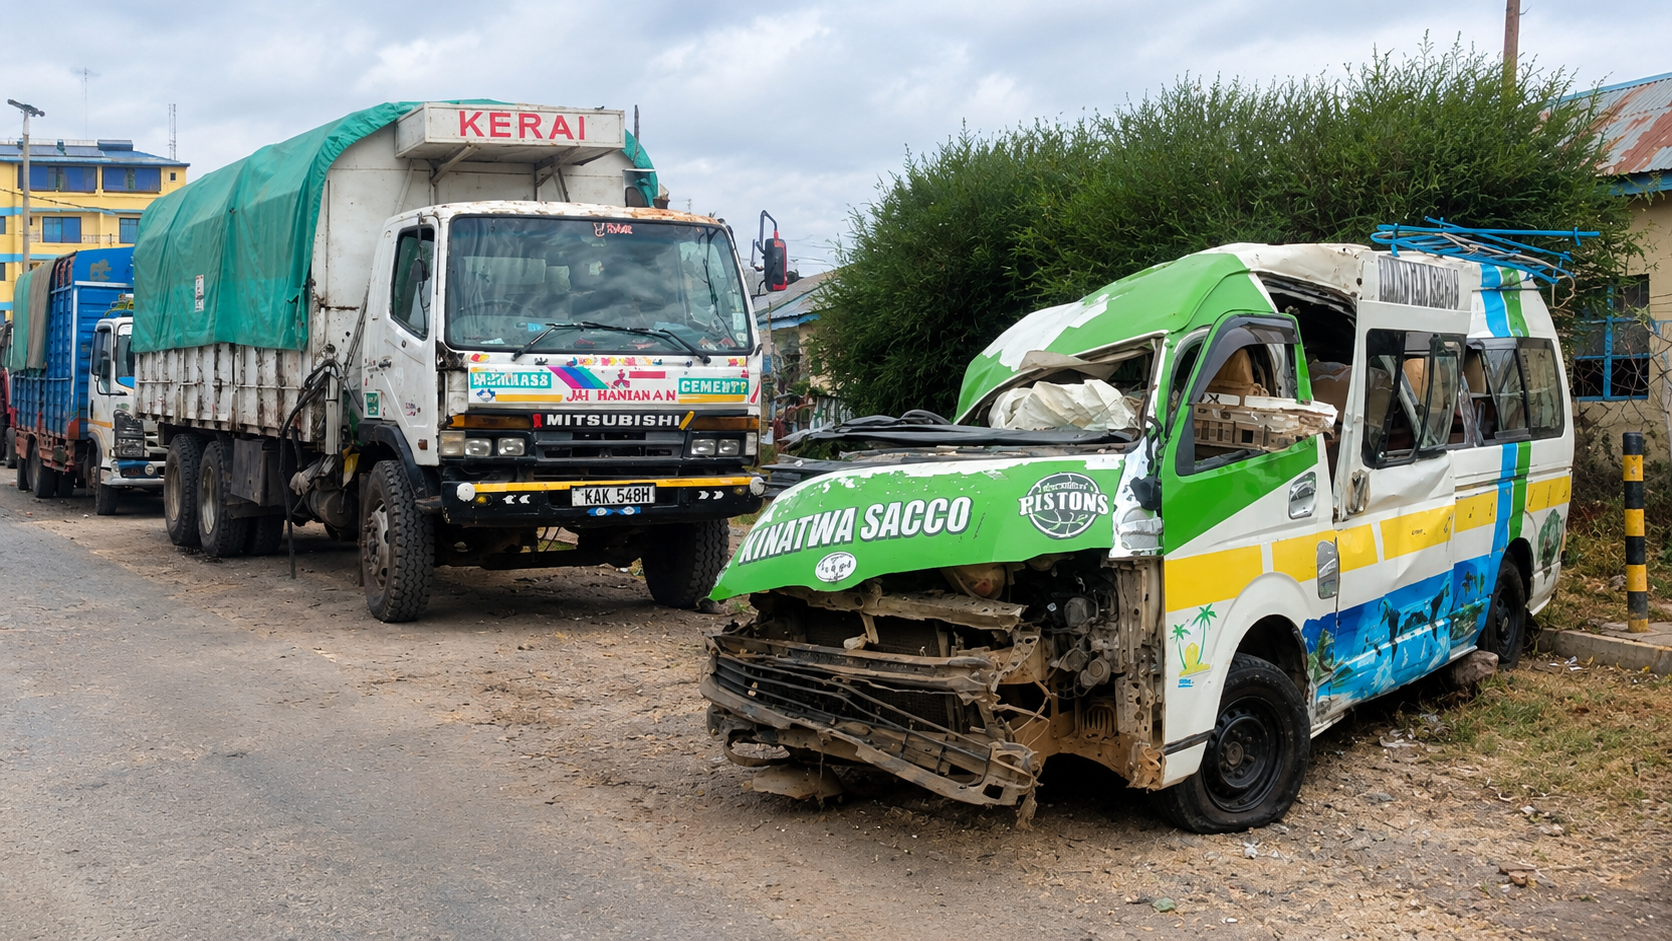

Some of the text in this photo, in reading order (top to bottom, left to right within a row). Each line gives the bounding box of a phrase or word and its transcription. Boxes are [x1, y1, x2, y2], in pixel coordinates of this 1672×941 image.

[459, 110, 585, 141] KERAI
[546, 414, 680, 427] MITSUBISHI
[1017, 491, 1109, 516] PISTONS
[738, 496, 974, 566] KINATWA SACCO
